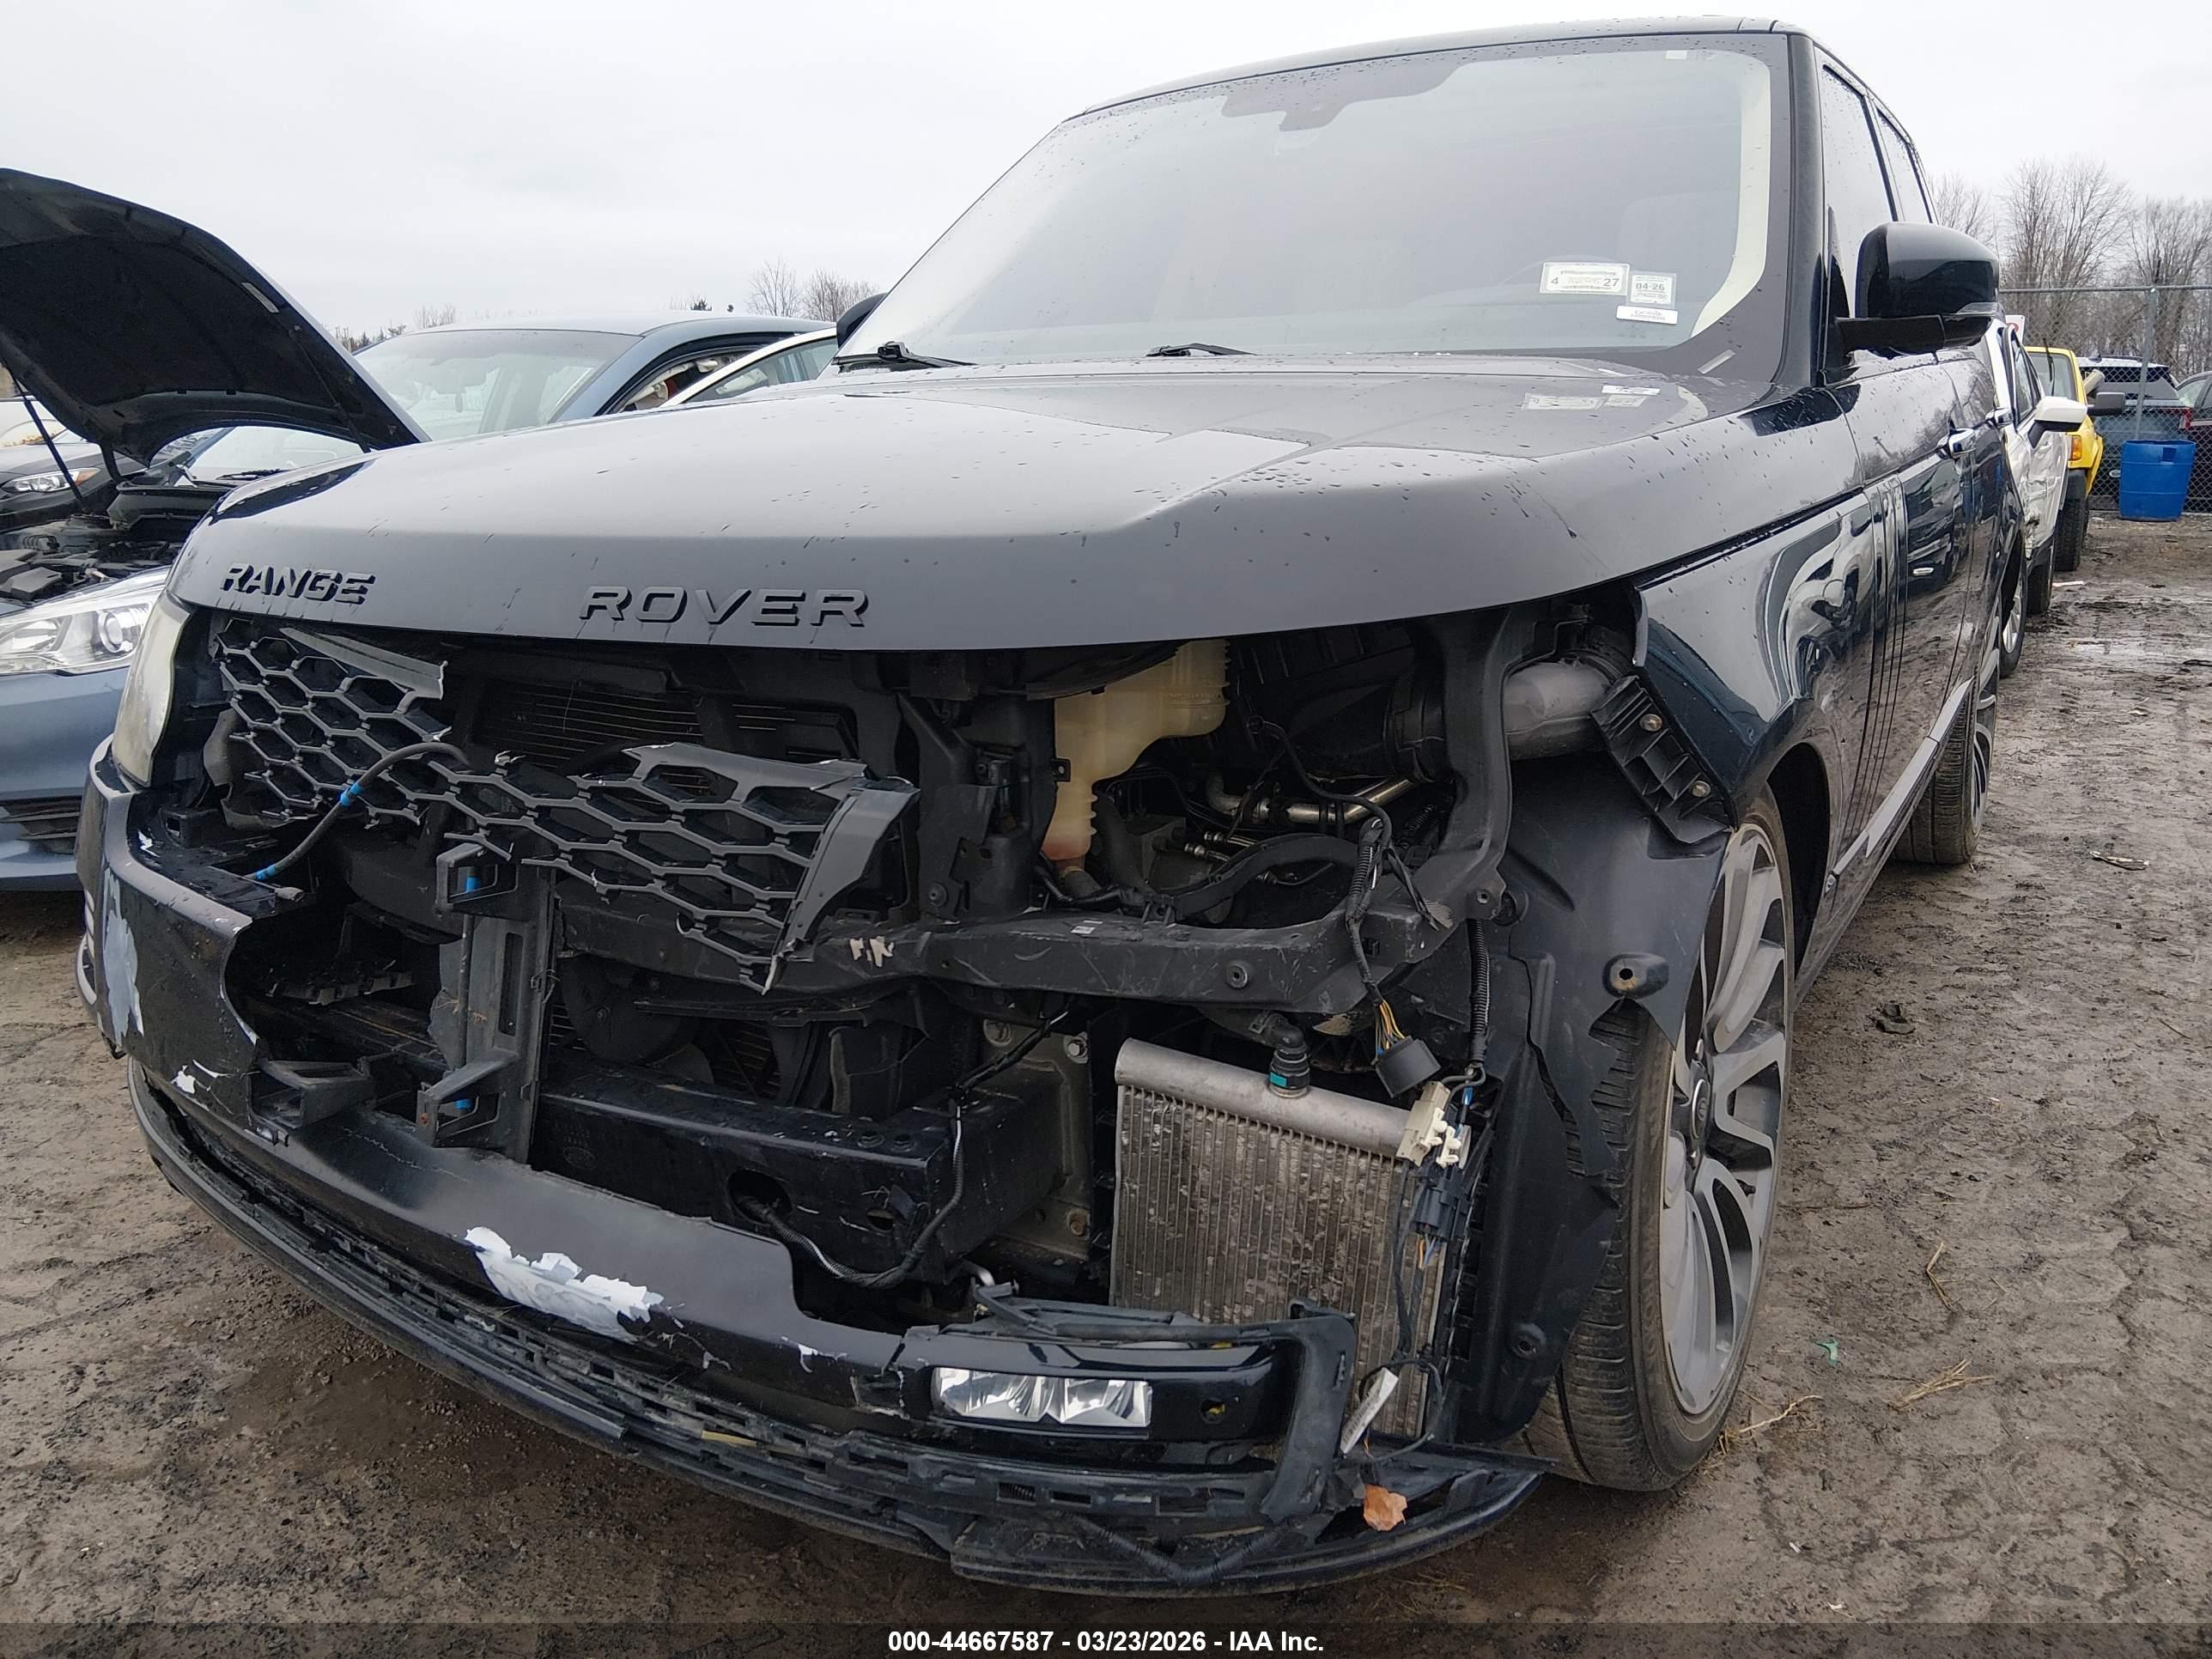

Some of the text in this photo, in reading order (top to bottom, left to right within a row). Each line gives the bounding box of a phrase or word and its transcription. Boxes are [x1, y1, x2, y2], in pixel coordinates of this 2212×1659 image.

[1603, 277, 1620, 287] 27
[220, 562, 376, 605] RANGE
[579, 586, 869, 627] ROVER
